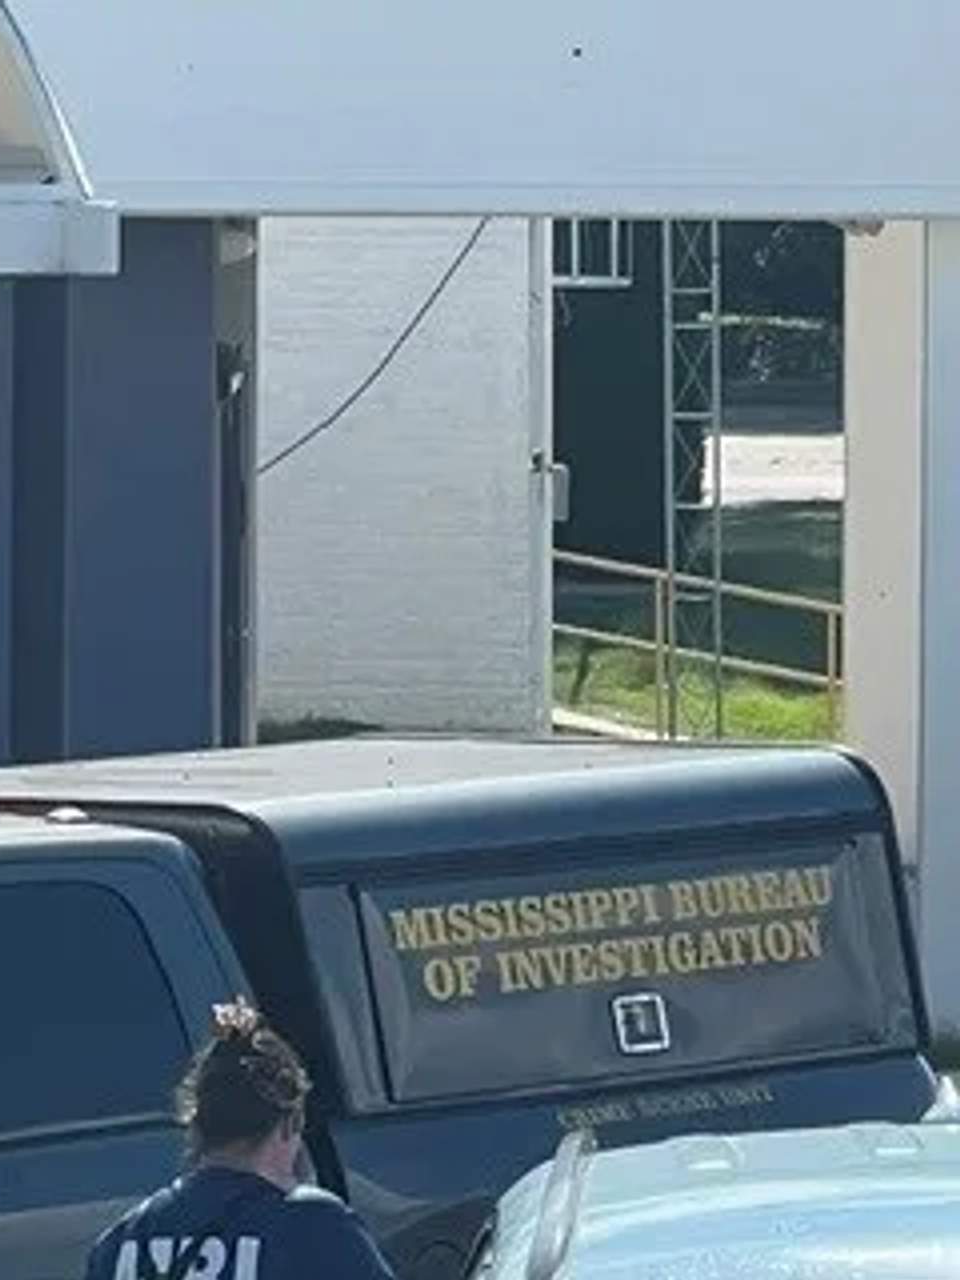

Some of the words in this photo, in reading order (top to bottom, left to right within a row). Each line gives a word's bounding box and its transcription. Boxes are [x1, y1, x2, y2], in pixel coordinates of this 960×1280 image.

[389, 884, 661, 950] MISSISSIPPI
[669, 865, 833, 922] BUREAU
[423, 955, 481, 1001] OF
[495, 917, 822, 993] INVESTIGATION
